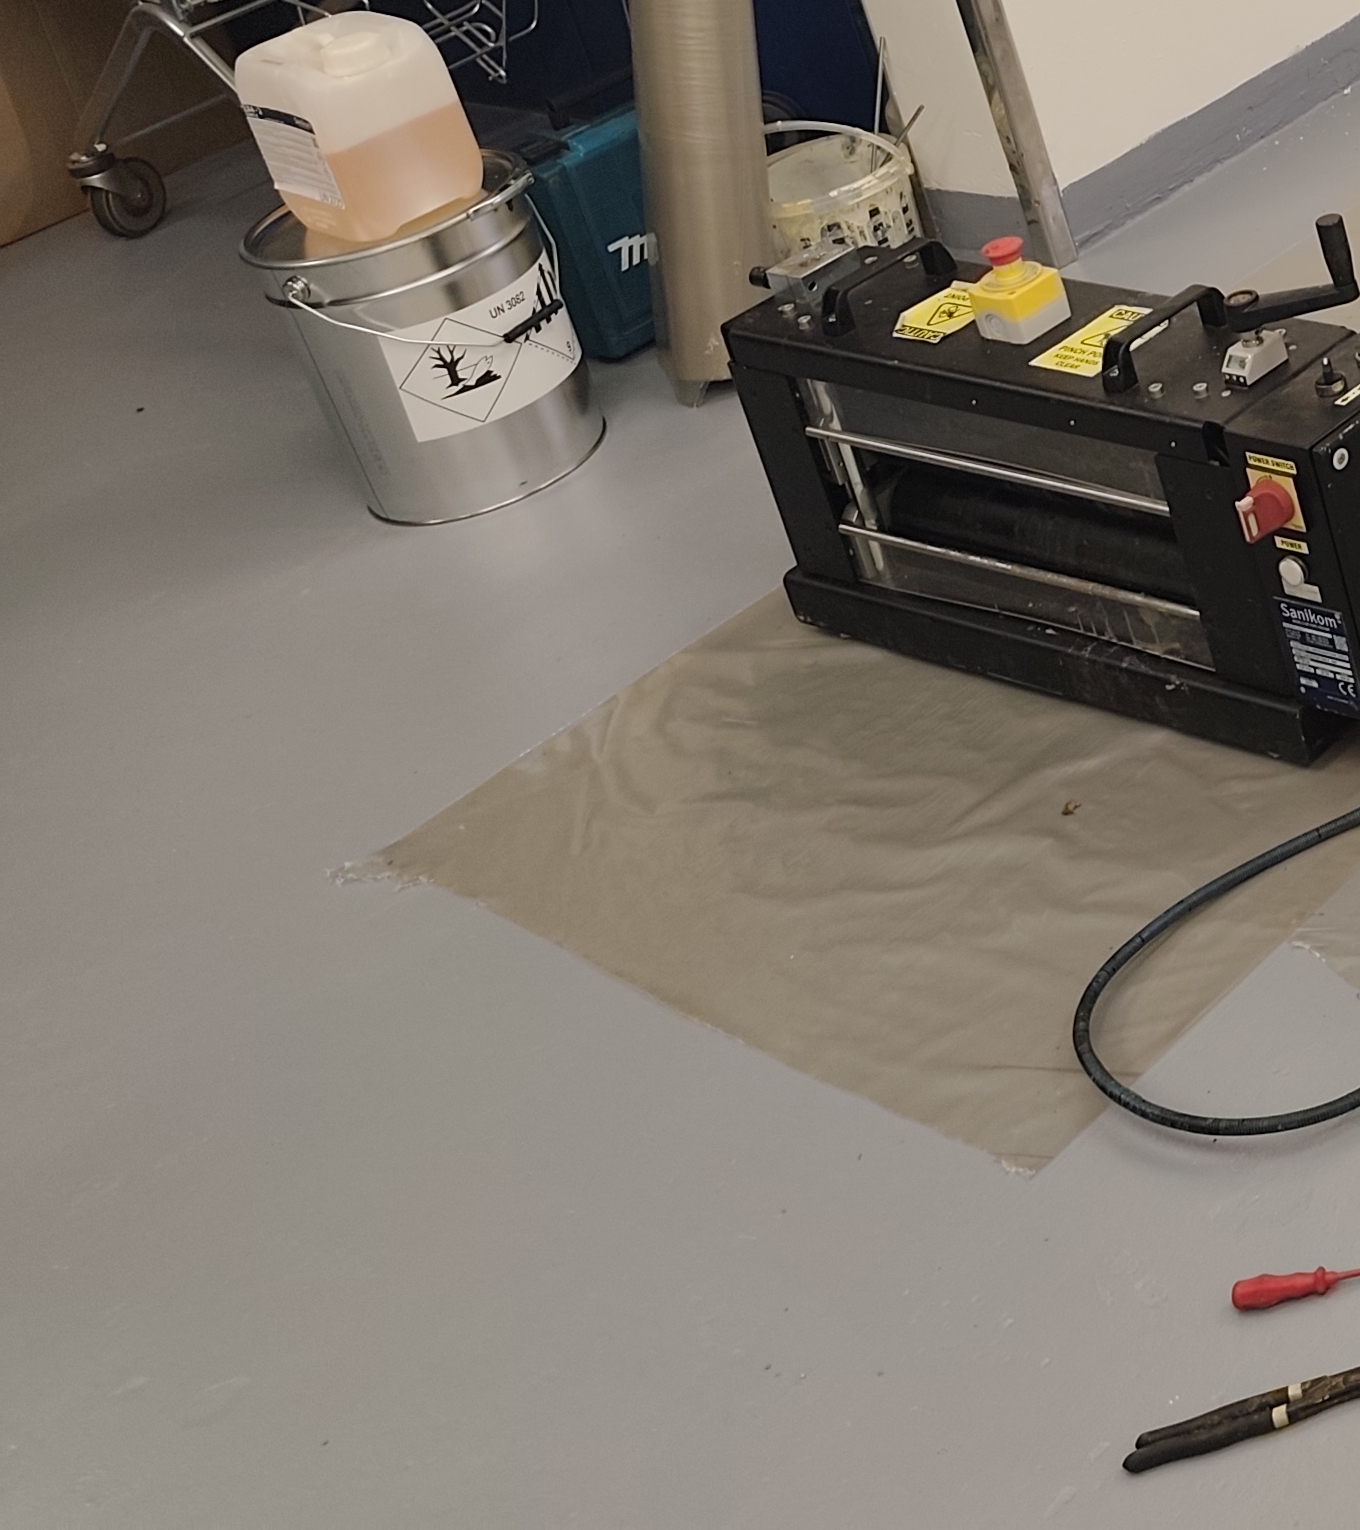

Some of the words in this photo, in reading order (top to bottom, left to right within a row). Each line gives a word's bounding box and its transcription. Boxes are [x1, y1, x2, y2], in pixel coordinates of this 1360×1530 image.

[489, 303, 505, 319] UN
[505, 291, 526, 310] 3082
[1248, 455, 1270, 467] POWER
[1270, 459, 1295, 471] SWITCH
[1280, 539, 1303, 550] POWER
[1280, 602, 1338, 629] Sanikom
